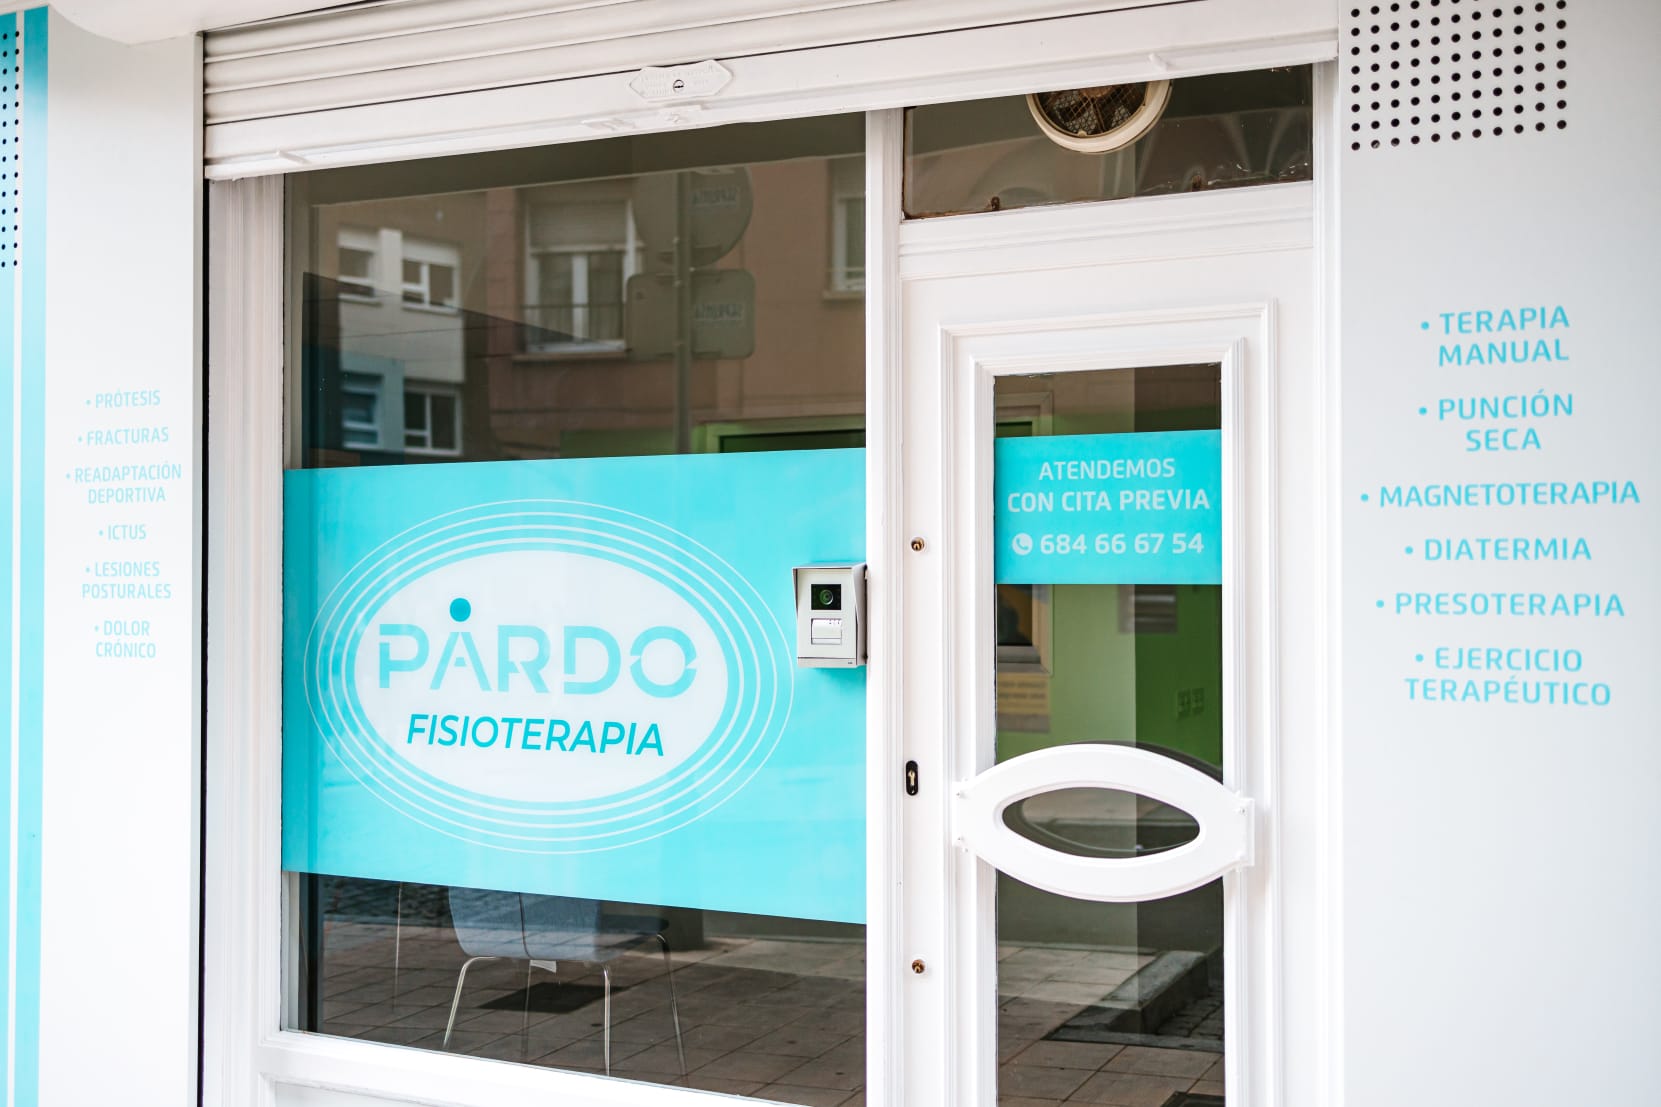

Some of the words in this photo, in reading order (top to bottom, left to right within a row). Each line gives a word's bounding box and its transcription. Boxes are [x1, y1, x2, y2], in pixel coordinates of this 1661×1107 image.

[1439, 305, 1570, 335] TERAPIA
[1438, 338, 1570, 367] MANUAL
[95, 389, 161, 408] PRÓTESIS
[1438, 388, 1573, 421] PUNCIÓN
[86, 427, 169, 446] FRACTURAS
[1465, 428, 1542, 452] SECA
[75, 460, 182, 483] READAPTACIÓN
[1038, 458, 1176, 481] ATENDEMOS
[88, 486, 166, 504] DEPORTIVA
[1007, 492, 1054, 513] CON
[1061, 490, 1112, 511] CITA
[1119, 489, 1210, 511] PREVIA
[1380, 481, 1641, 507] MAGNETOTERAPIA
[107, 524, 147, 540] ICTUS
[1040, 534, 1087, 555] 684
[1094, 533, 1126, 555] 66
[1134, 533, 1165, 554] 67
[1172, 532, 1204, 554] 54
[1424, 537, 1592, 561] DIATERMIA
[94, 561, 160, 577] LESIONES
[82, 583, 172, 599] POSTURALES
[1395, 592, 1625, 617] PRESOTERAPIA
[103, 620, 150, 636] DOLOR
[96, 639, 156, 659] CRÓNICO
[1435, 647, 1583, 672] EJERCICIO
[1404, 675, 1611, 706] TERAPÉUTICO
[407, 713, 664, 757] FISIOTERAPIA
